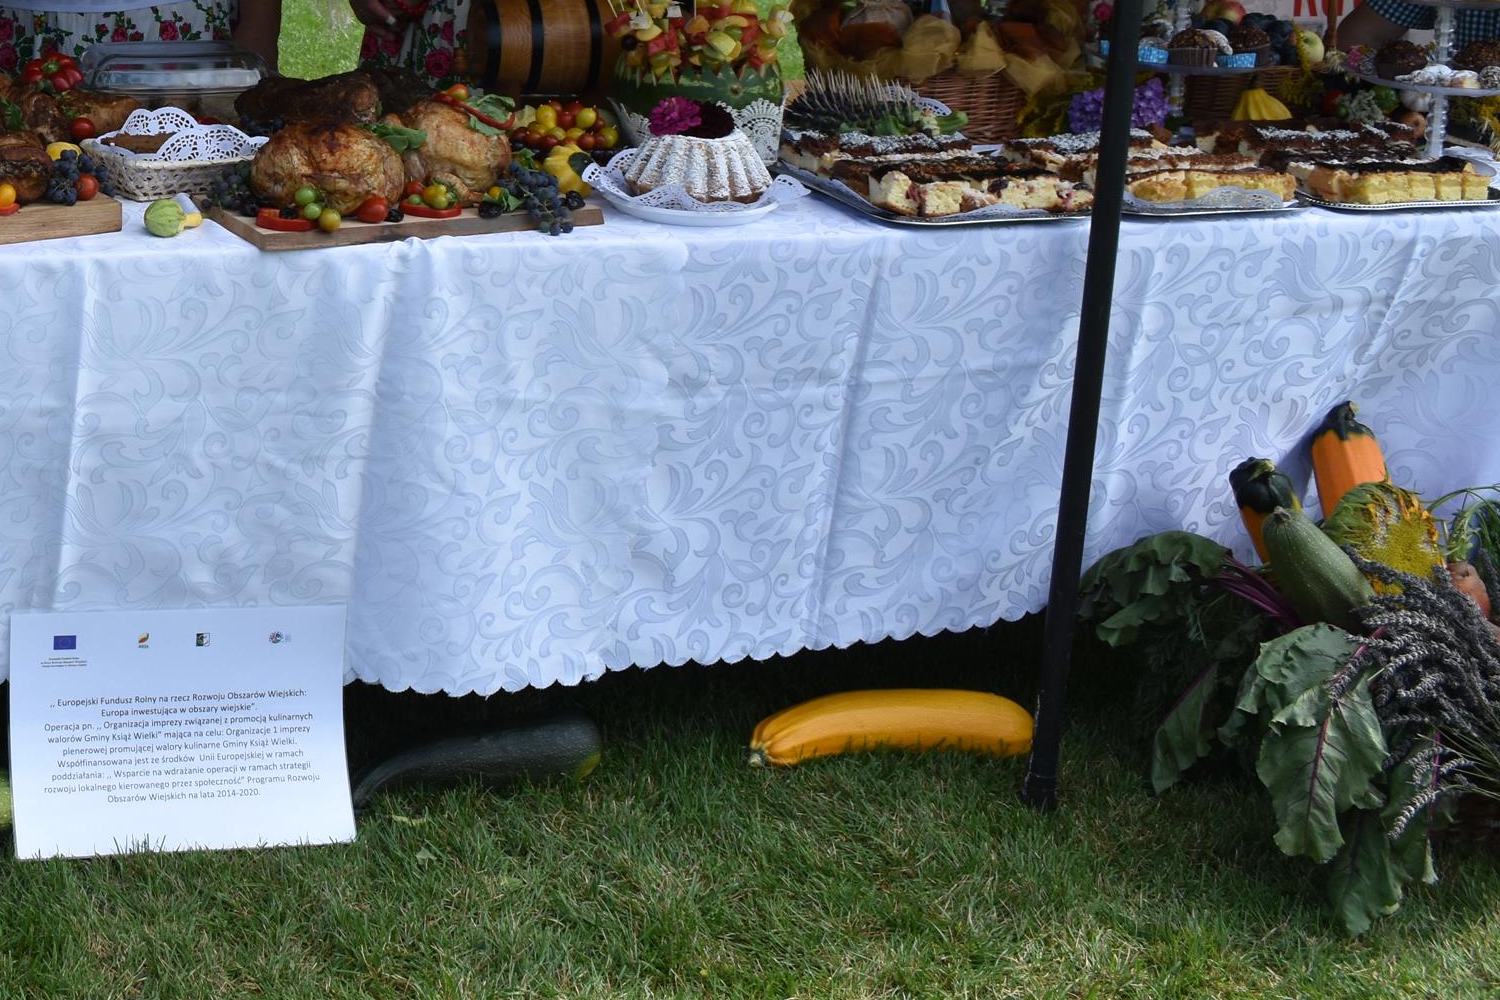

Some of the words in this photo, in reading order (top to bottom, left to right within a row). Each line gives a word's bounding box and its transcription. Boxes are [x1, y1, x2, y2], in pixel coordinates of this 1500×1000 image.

[57, 697, 98, 707] Europejski
[100, 696, 132, 705] Fundusz
[134, 695, 157, 704] Rolny
[192, 693, 225, 702] Rozwoju
[227, 691, 265, 700] Obszarów
[267, 689, 307, 698] Wiejskich:
[101, 709, 129, 718] Europa
[131, 706, 178, 716] inwestująca
[188, 704, 219, 713] obszary
[44, 723, 80, 732] Operacja
[103, 720, 150, 730] Organizacja
[151, 718, 182, 728] imprezy
[184, 716, 223, 726] związanej
[230, 715, 267, 724] promocją
[268, 712, 313, 722] kulinarnych
[48, 734, 82, 743] walorów
[84, 733, 110, 743] Gminy
[112, 732, 132, 742] Książ
[164, 730, 192, 740] mająca
[205, 729, 224, 737] celu:
[225, 726, 271, 737] Organizacje
[280, 725, 311, 734] imprezy
[62, 746, 108, 757] plenerowej
[109, 744, 155, 754] promującej
[155, 742, 182, 751] walory
[184, 741, 221, 750] kulinarne
[222, 740, 248, 749] Gminy
[249, 738, 269, 748] Książ
[270, 737, 297, 746] Wielki.
[57, 756, 132, 768] Współfinansowana
[134, 757, 149, 766] jest
[161, 754, 195, 764] środków
[199, 753, 215, 761] Unii
[217, 751, 265, 761] Europejskiej
[274, 749, 304, 758] ramach
[52, 771, 104, 782] poddziałania:
[113, 768, 150, 778] Wsparcie
[164, 766, 205, 776] wdrażanie
[206, 765, 238, 775] operacji
[248, 762, 278, 771] ramach
[279, 761, 311, 771] strategii
[44, 785, 77, 794] rozwoju
[78, 783, 117, 792] lokalnego
[118, 780, 170, 791] kierowanego
[171, 780, 193, 789] przez
[247, 775, 286, 785] Programu
[287, 772, 320, 782] Rozwoju
[107, 794, 147, 803] Obszarów
[148, 791, 187, 802] Wiejskich
[200, 790, 215, 798] lata
[217, 788, 260, 798] 2014-2020.
